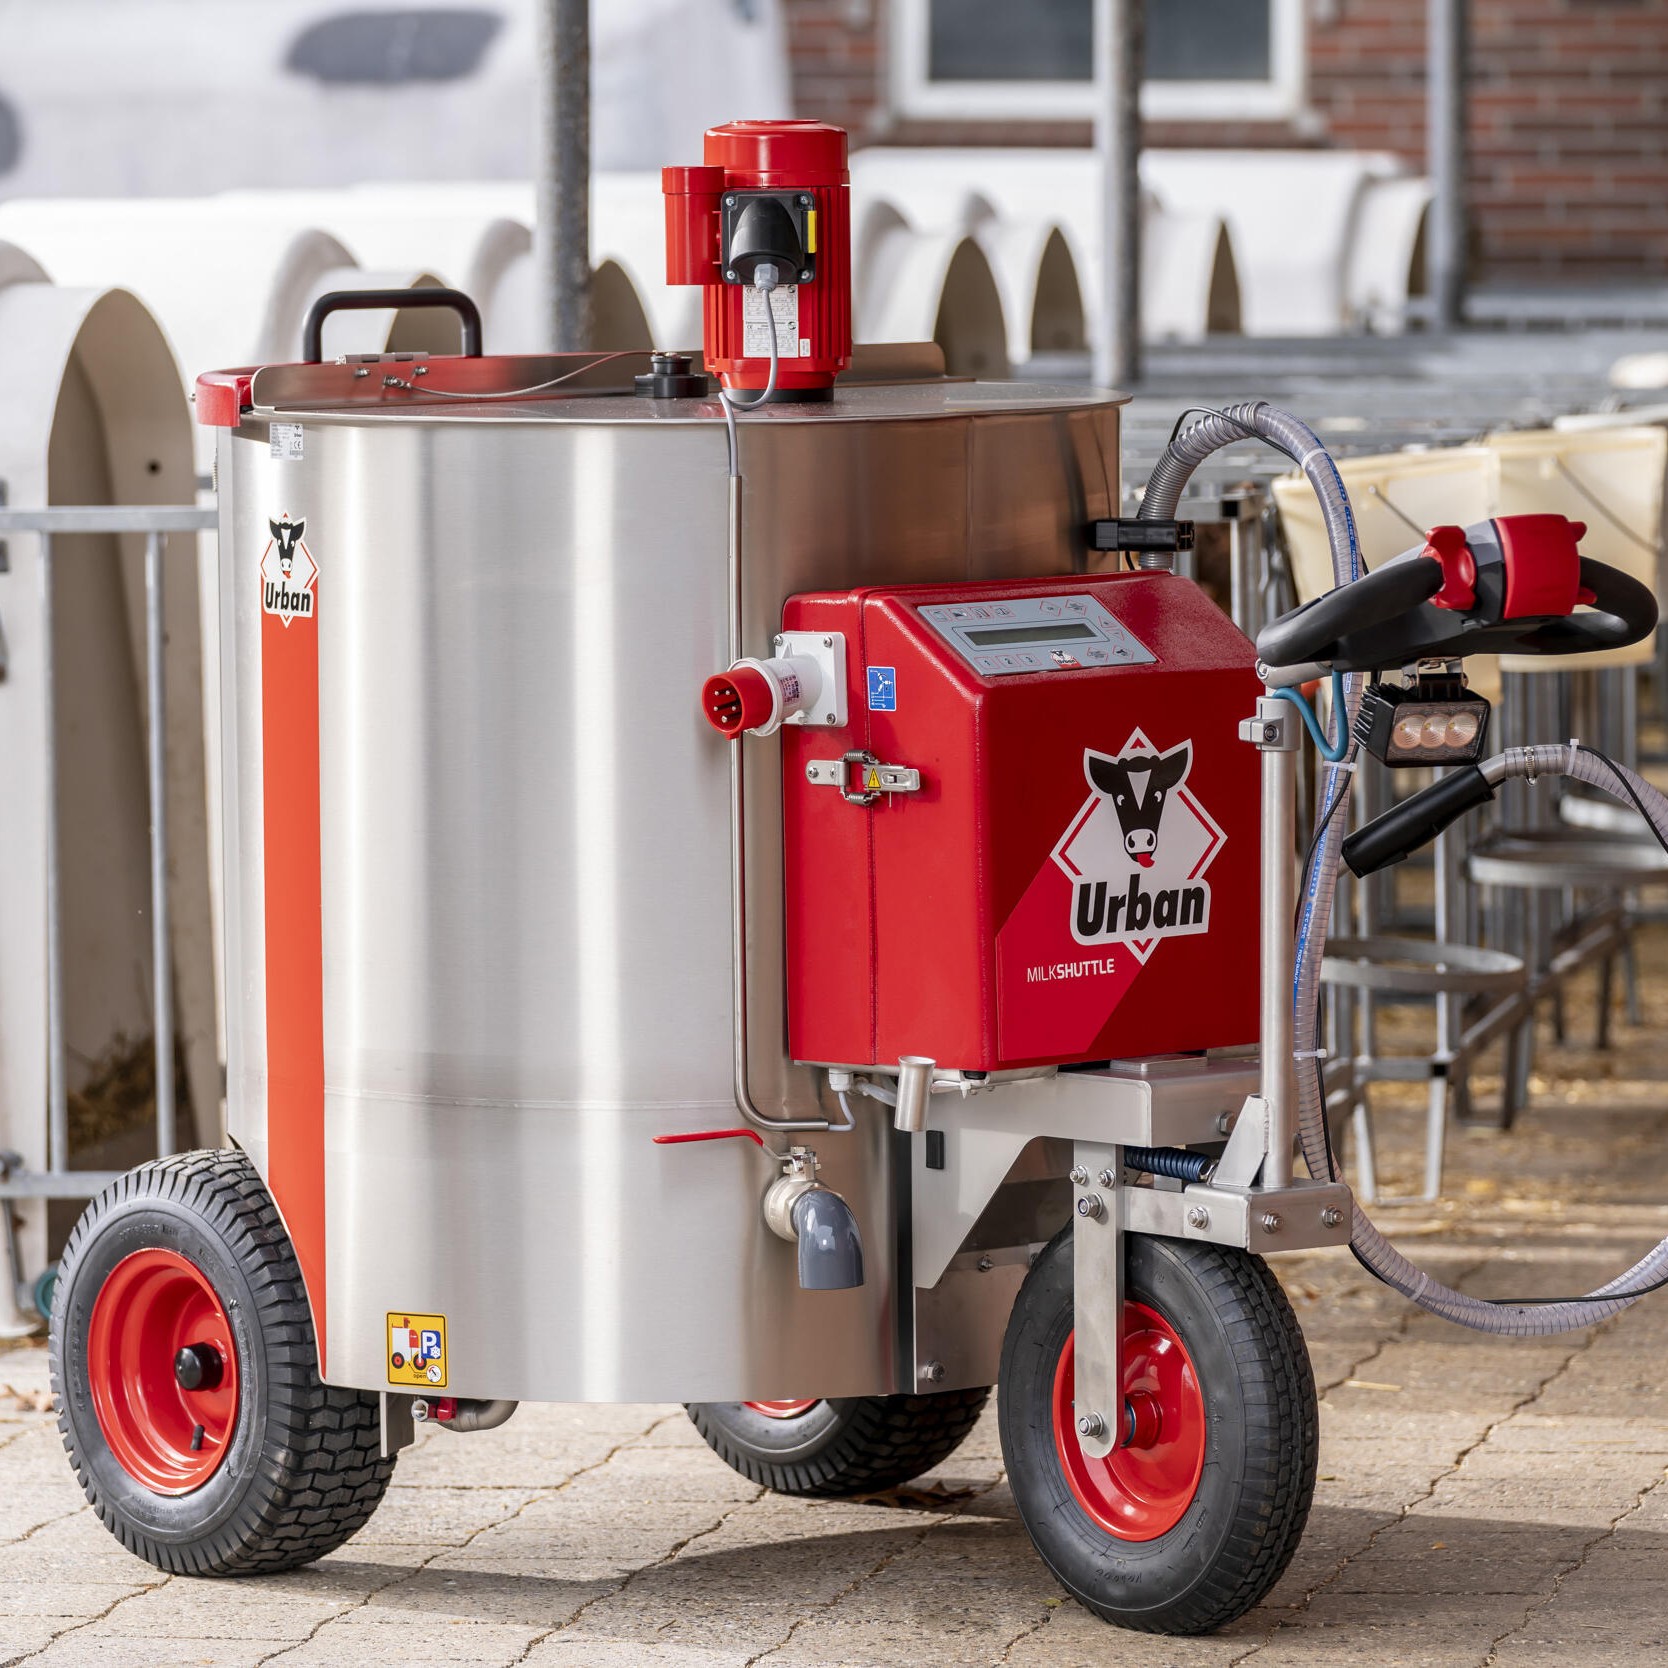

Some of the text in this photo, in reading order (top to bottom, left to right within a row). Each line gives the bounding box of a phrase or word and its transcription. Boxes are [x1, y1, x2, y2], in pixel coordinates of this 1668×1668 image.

[265, 581, 311, 612] Urban
[1077, 873, 1205, 937] Urban
[1027, 958, 1115, 982] MILKSHUTTLE
[422, 1332, 437, 1354] P
